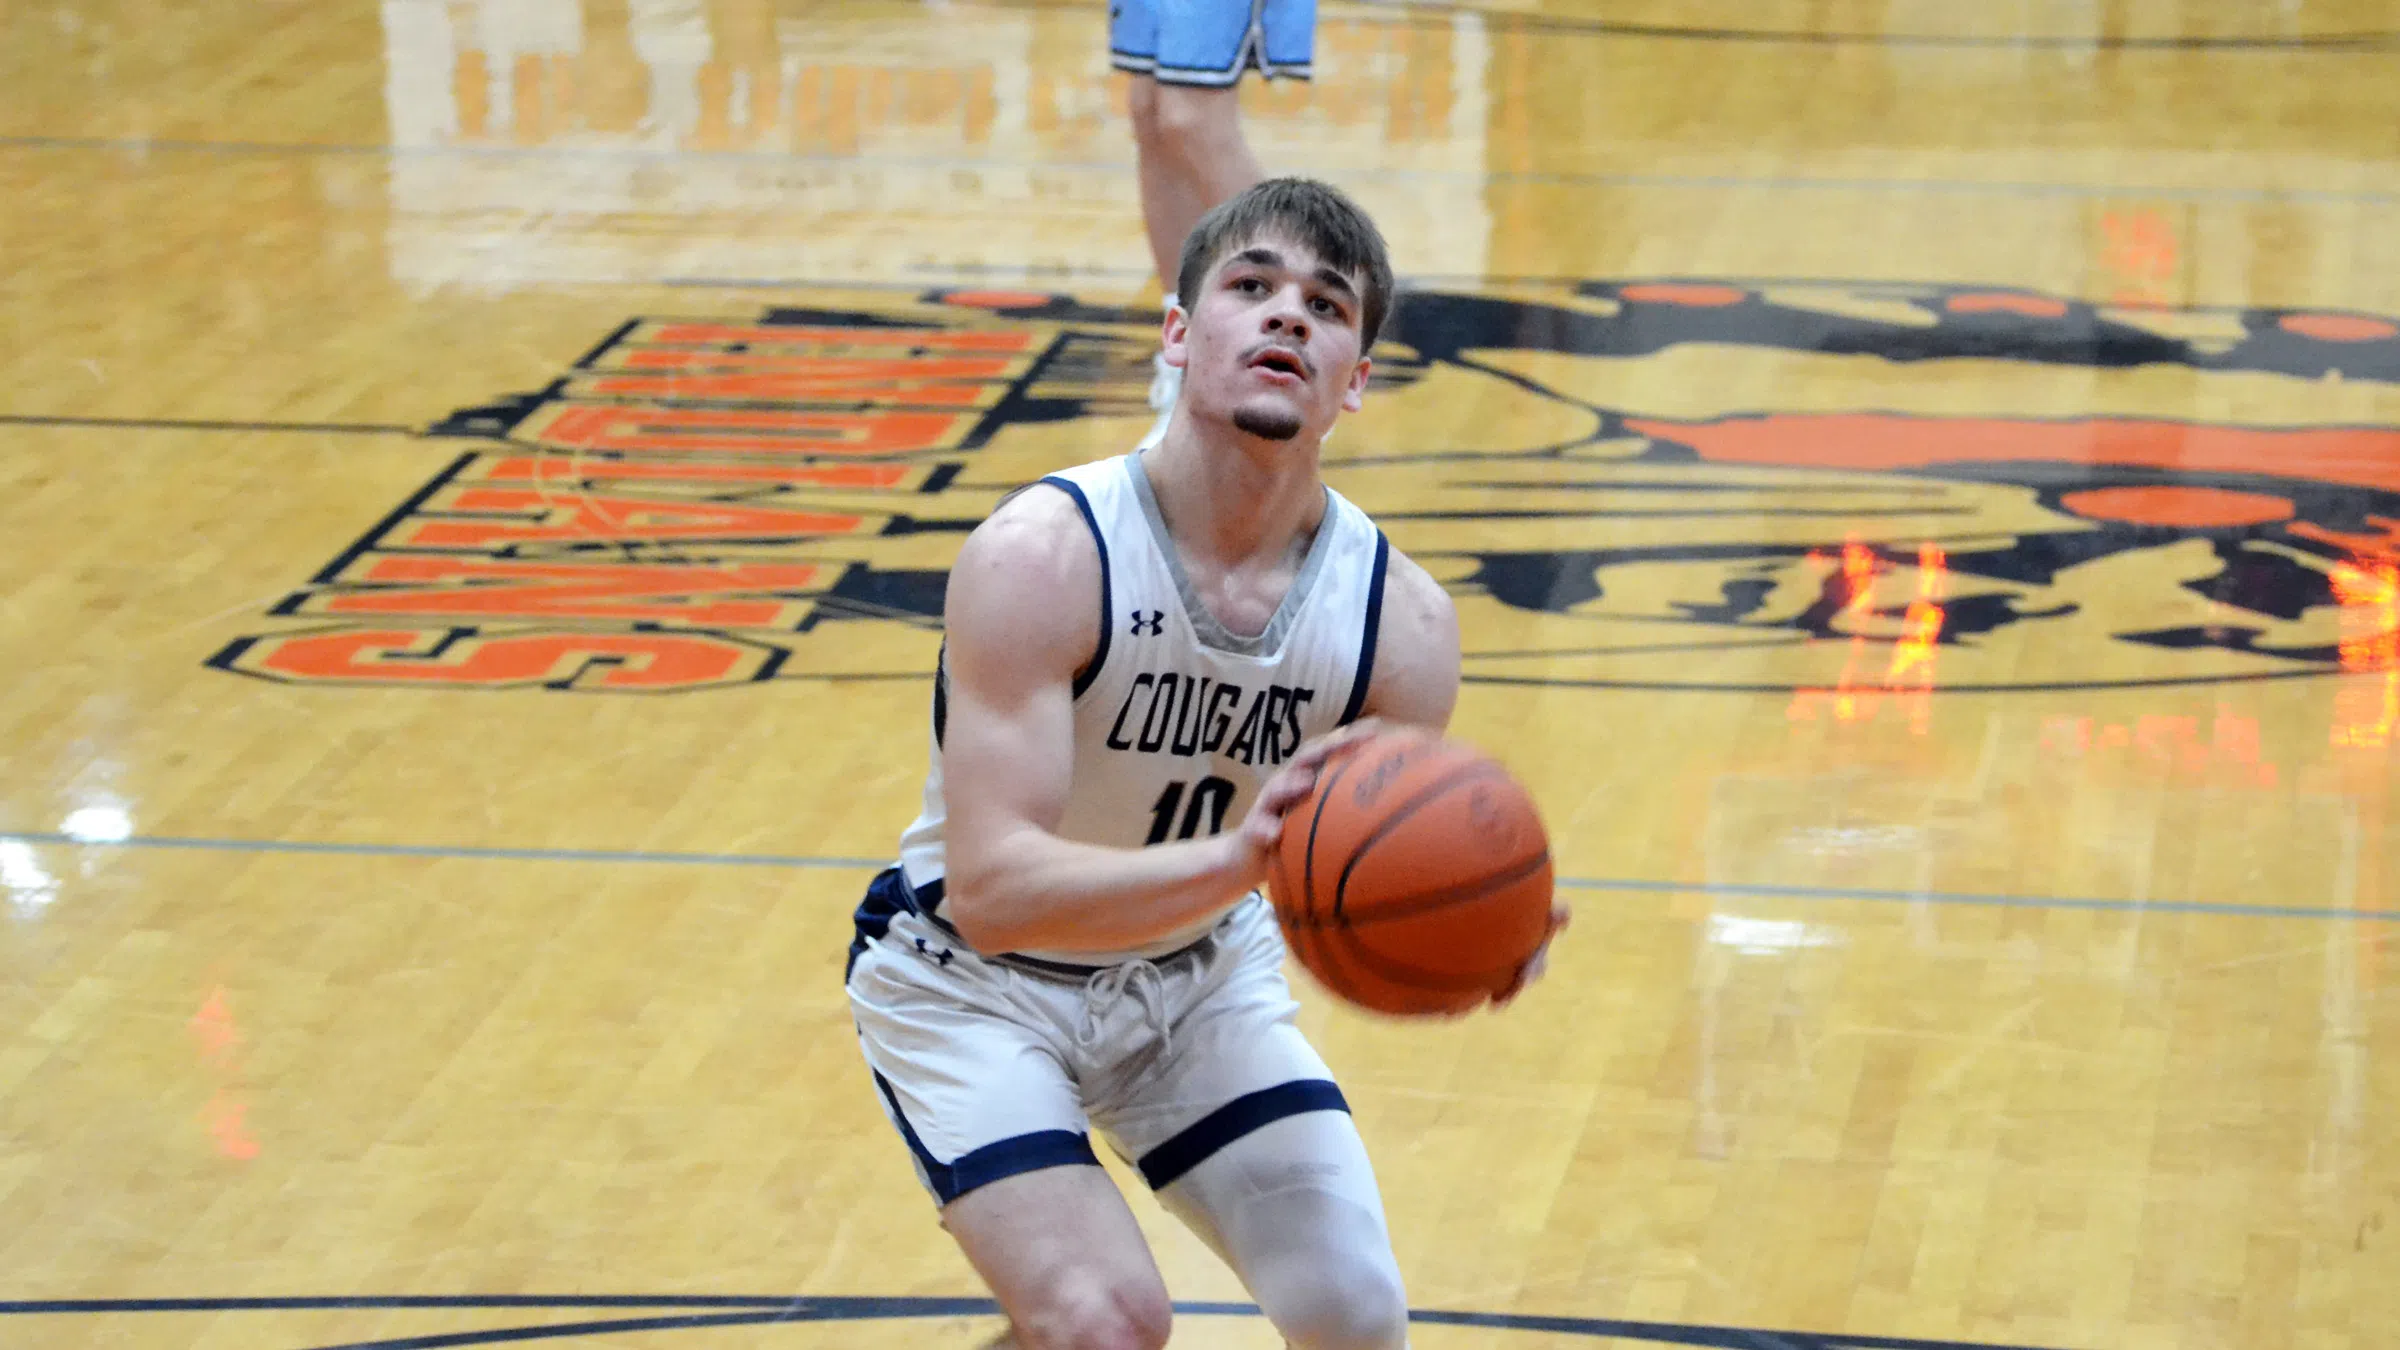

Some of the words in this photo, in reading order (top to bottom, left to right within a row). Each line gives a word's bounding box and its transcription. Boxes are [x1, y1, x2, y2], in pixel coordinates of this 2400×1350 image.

[206, 318, 1060, 691] INDIANS
[1106, 672, 1314, 766] COUGARS
[1143, 775, 1236, 846] 10
